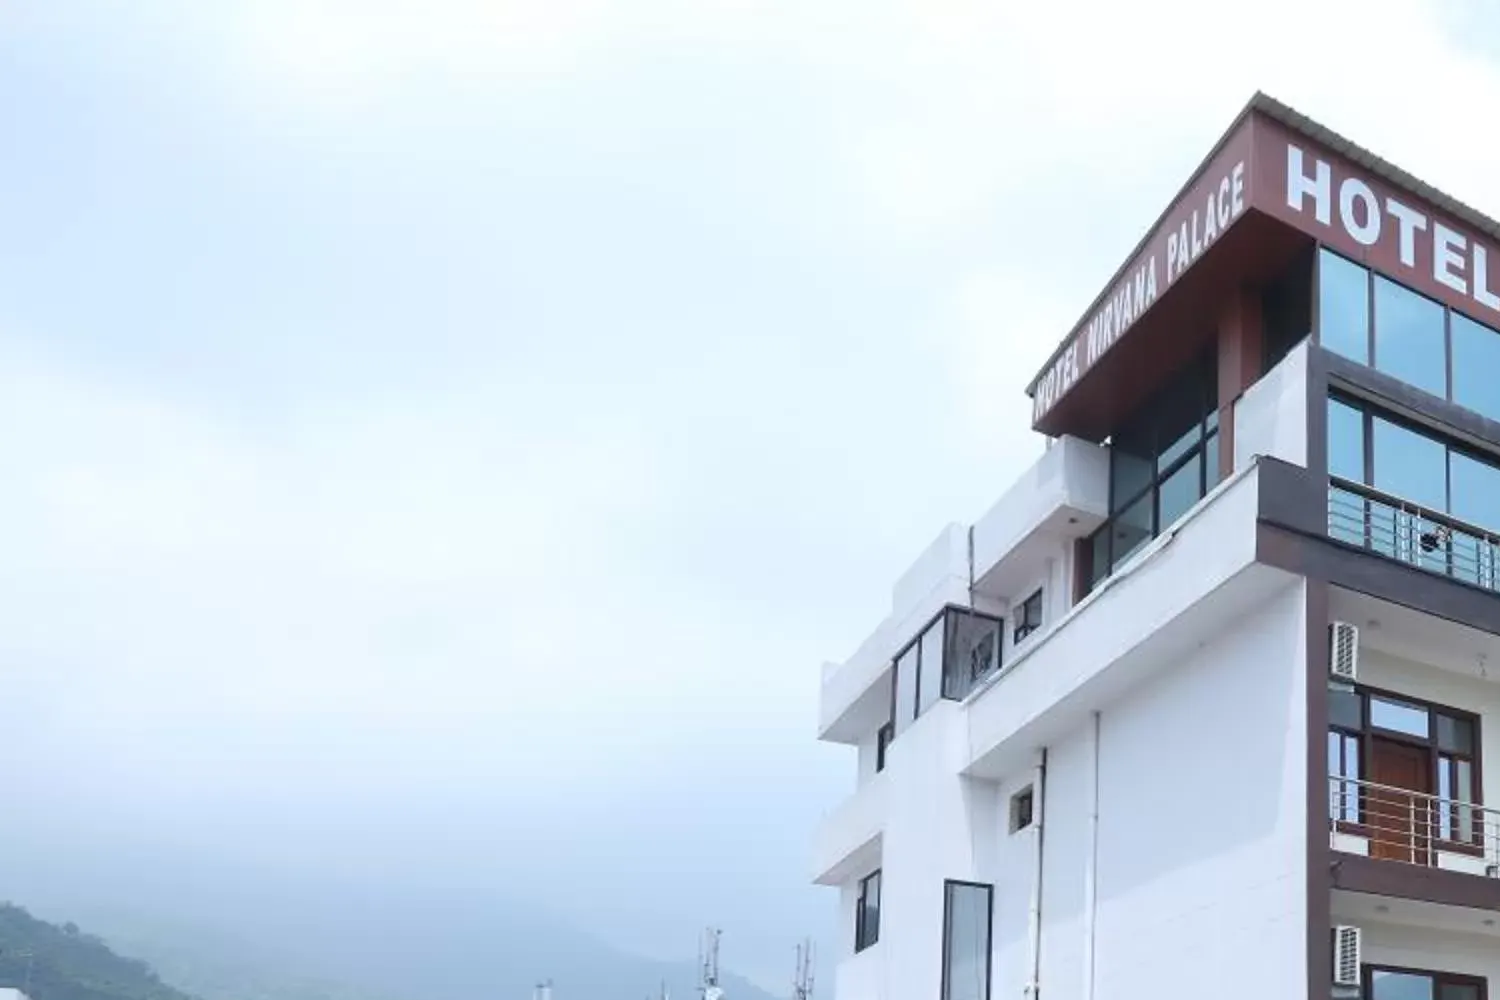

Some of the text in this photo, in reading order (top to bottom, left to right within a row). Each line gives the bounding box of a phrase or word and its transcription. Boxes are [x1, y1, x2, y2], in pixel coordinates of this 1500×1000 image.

[1034, 160, 1245, 421] HOTEL NIRVANA PALACE
